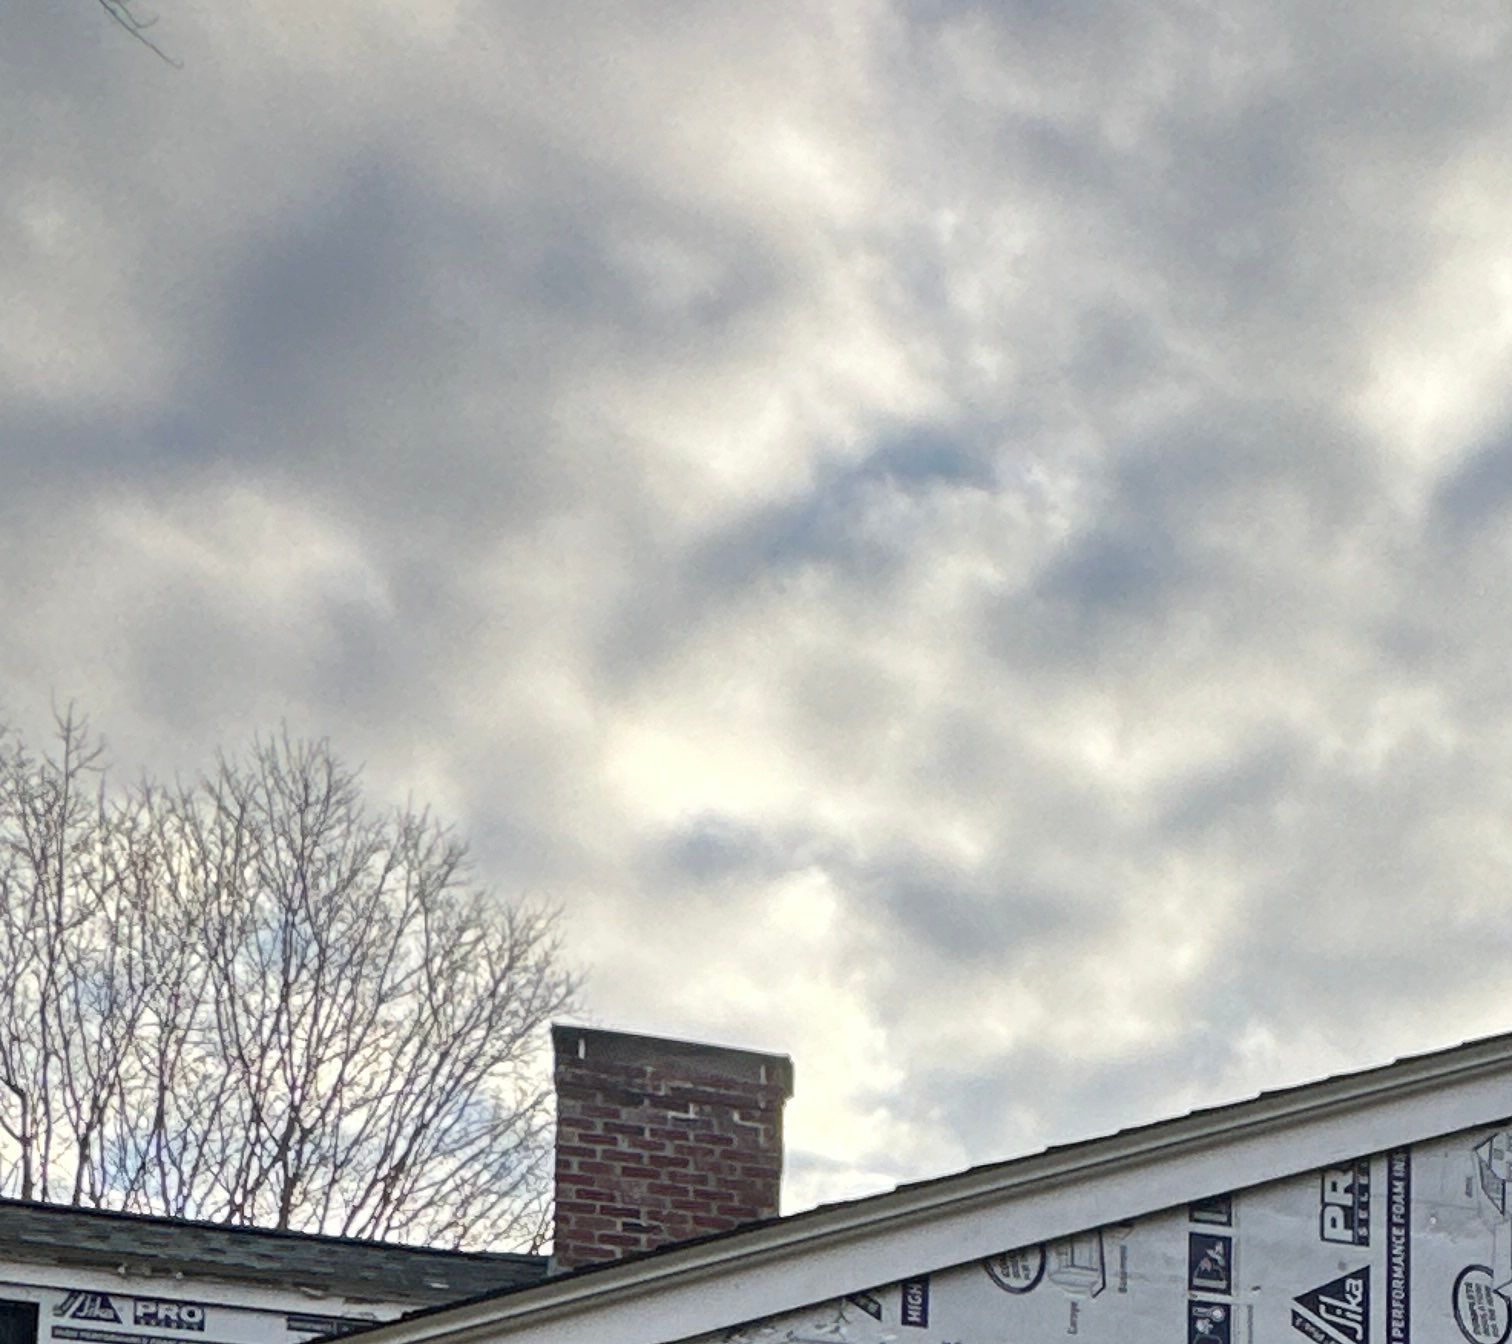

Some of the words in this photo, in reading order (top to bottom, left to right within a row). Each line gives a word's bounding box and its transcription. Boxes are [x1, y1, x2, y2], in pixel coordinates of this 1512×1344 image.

[1392, 1192, 1407, 1226] FOAM
[1392, 1231, 1407, 1341] PERFORMANCE
[136, 1302, 204, 1322] PRO
[1318, 1279, 1364, 1342] Sika
